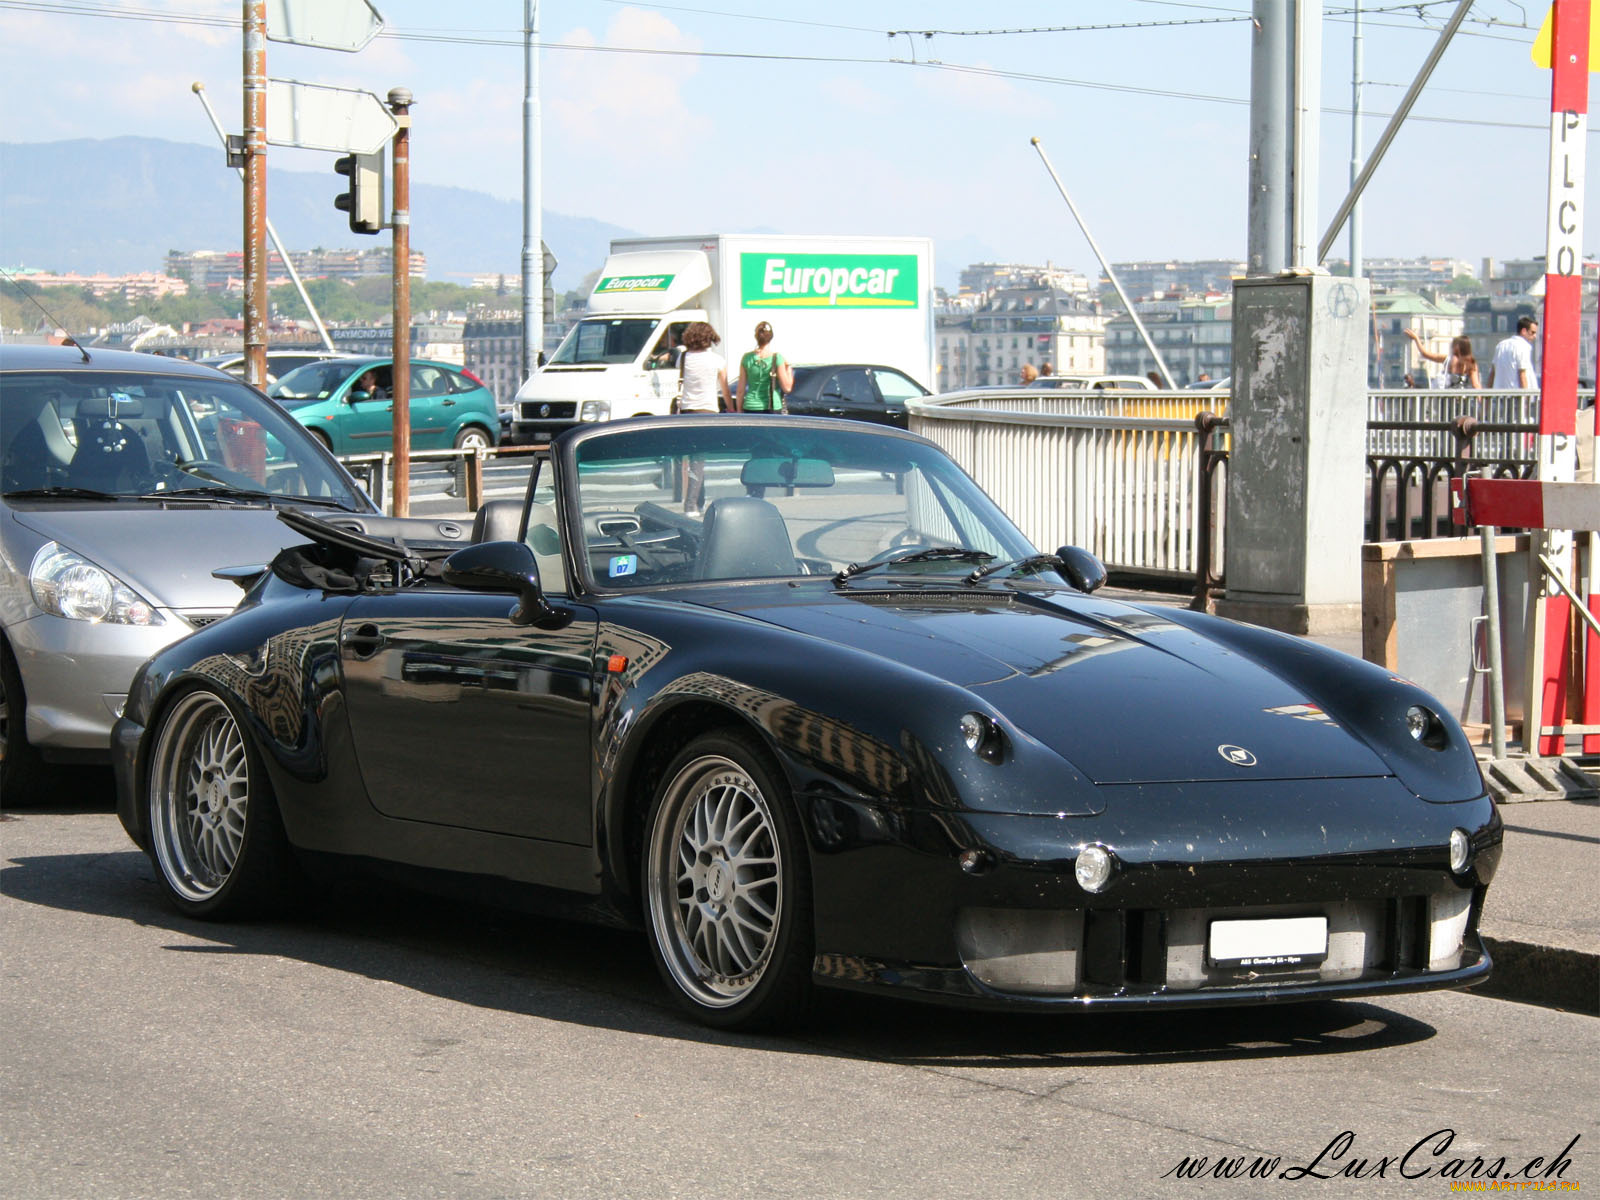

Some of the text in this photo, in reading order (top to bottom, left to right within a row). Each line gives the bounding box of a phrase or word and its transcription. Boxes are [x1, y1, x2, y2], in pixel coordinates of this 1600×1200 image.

[1557, 109, 1579, 278] PLCO
[605, 277, 665, 290] Europcar
[763, 259, 899, 305] Europcar
[334, 328, 394, 339] RAYMOND WE
[616, 564, 629, 574] 07
